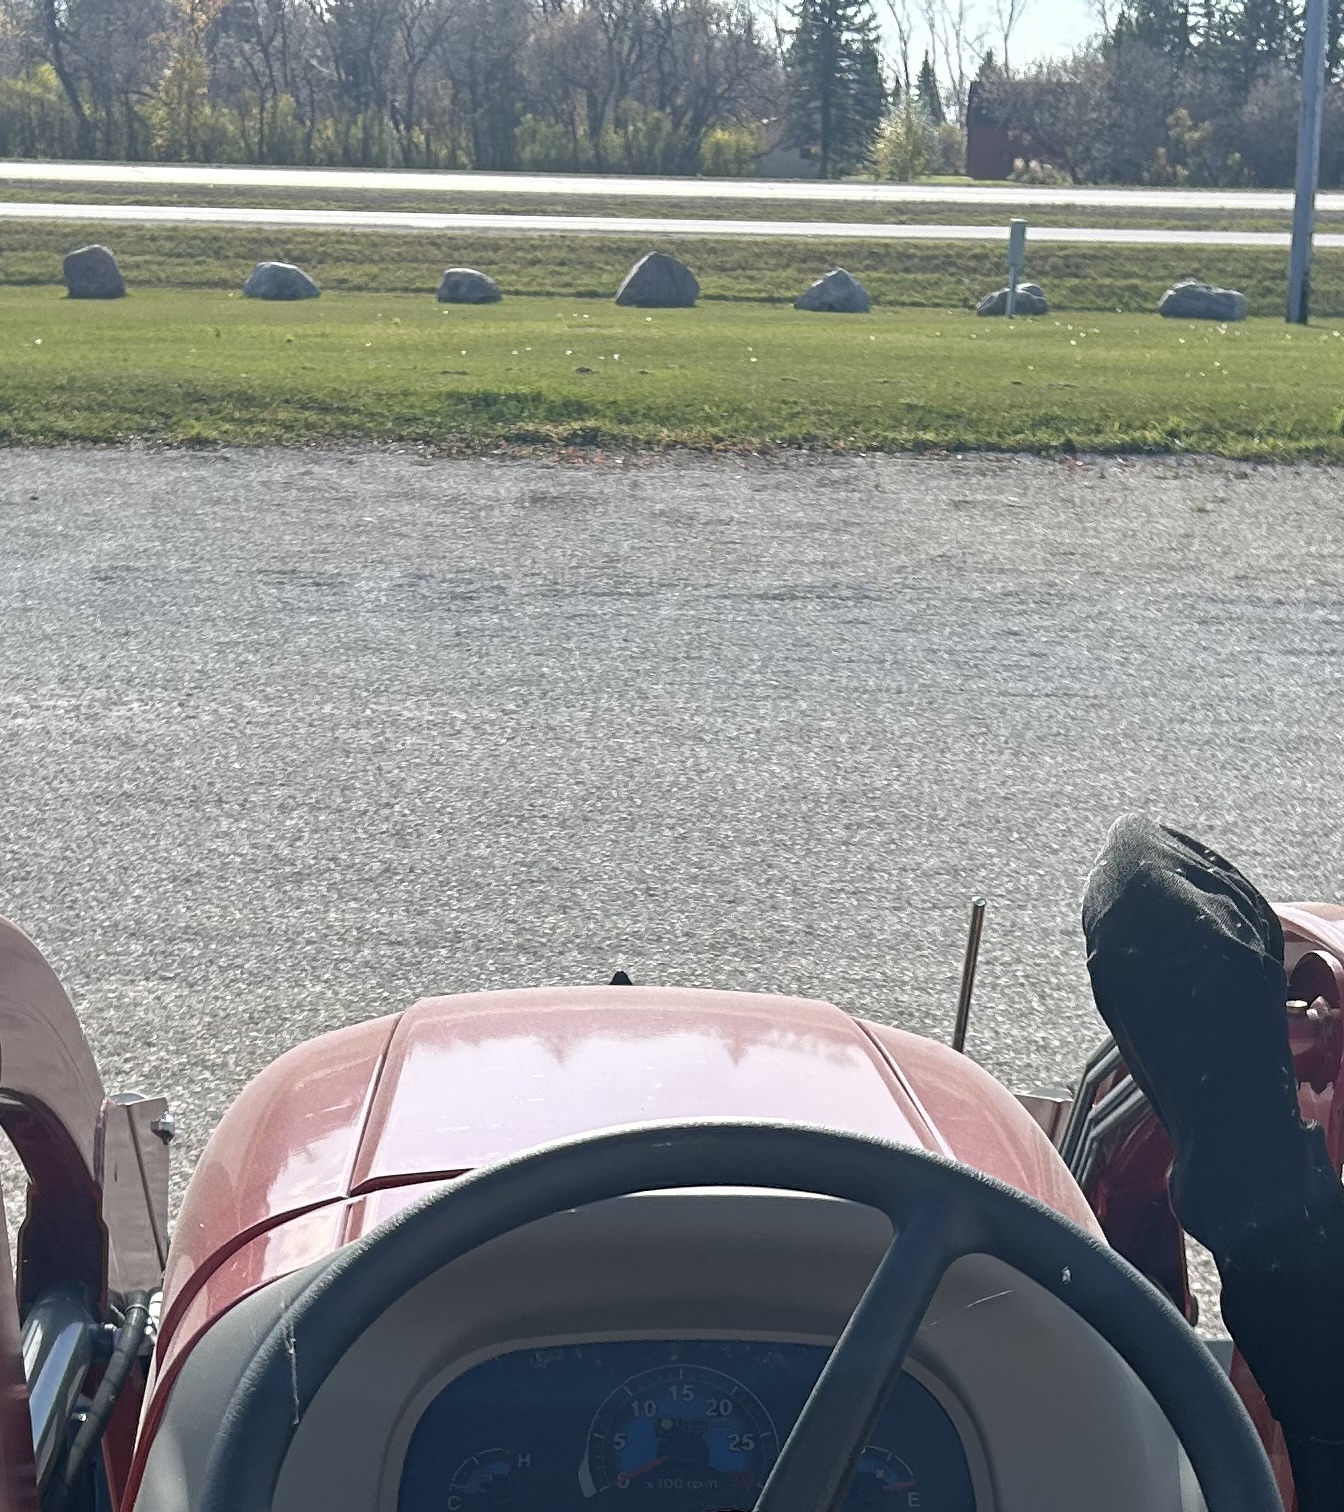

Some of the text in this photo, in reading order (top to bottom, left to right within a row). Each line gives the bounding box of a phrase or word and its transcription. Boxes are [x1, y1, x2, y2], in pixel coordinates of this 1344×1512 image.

[669, 1384, 695, 1402] 15
[632, 1400, 656, 1418] 10
[705, 1398, 733, 1416] 20
[613, 1432, 627, 1450] 5
[728, 1433, 755, 1452] 25
[518, 1453, 531, 1468] H
[658, 1479, 684, 1489] 100
[687, 1480, 718, 1490] rpm
[447, 1495, 461, 1511] C
[908, 1492, 921, 1508] E
